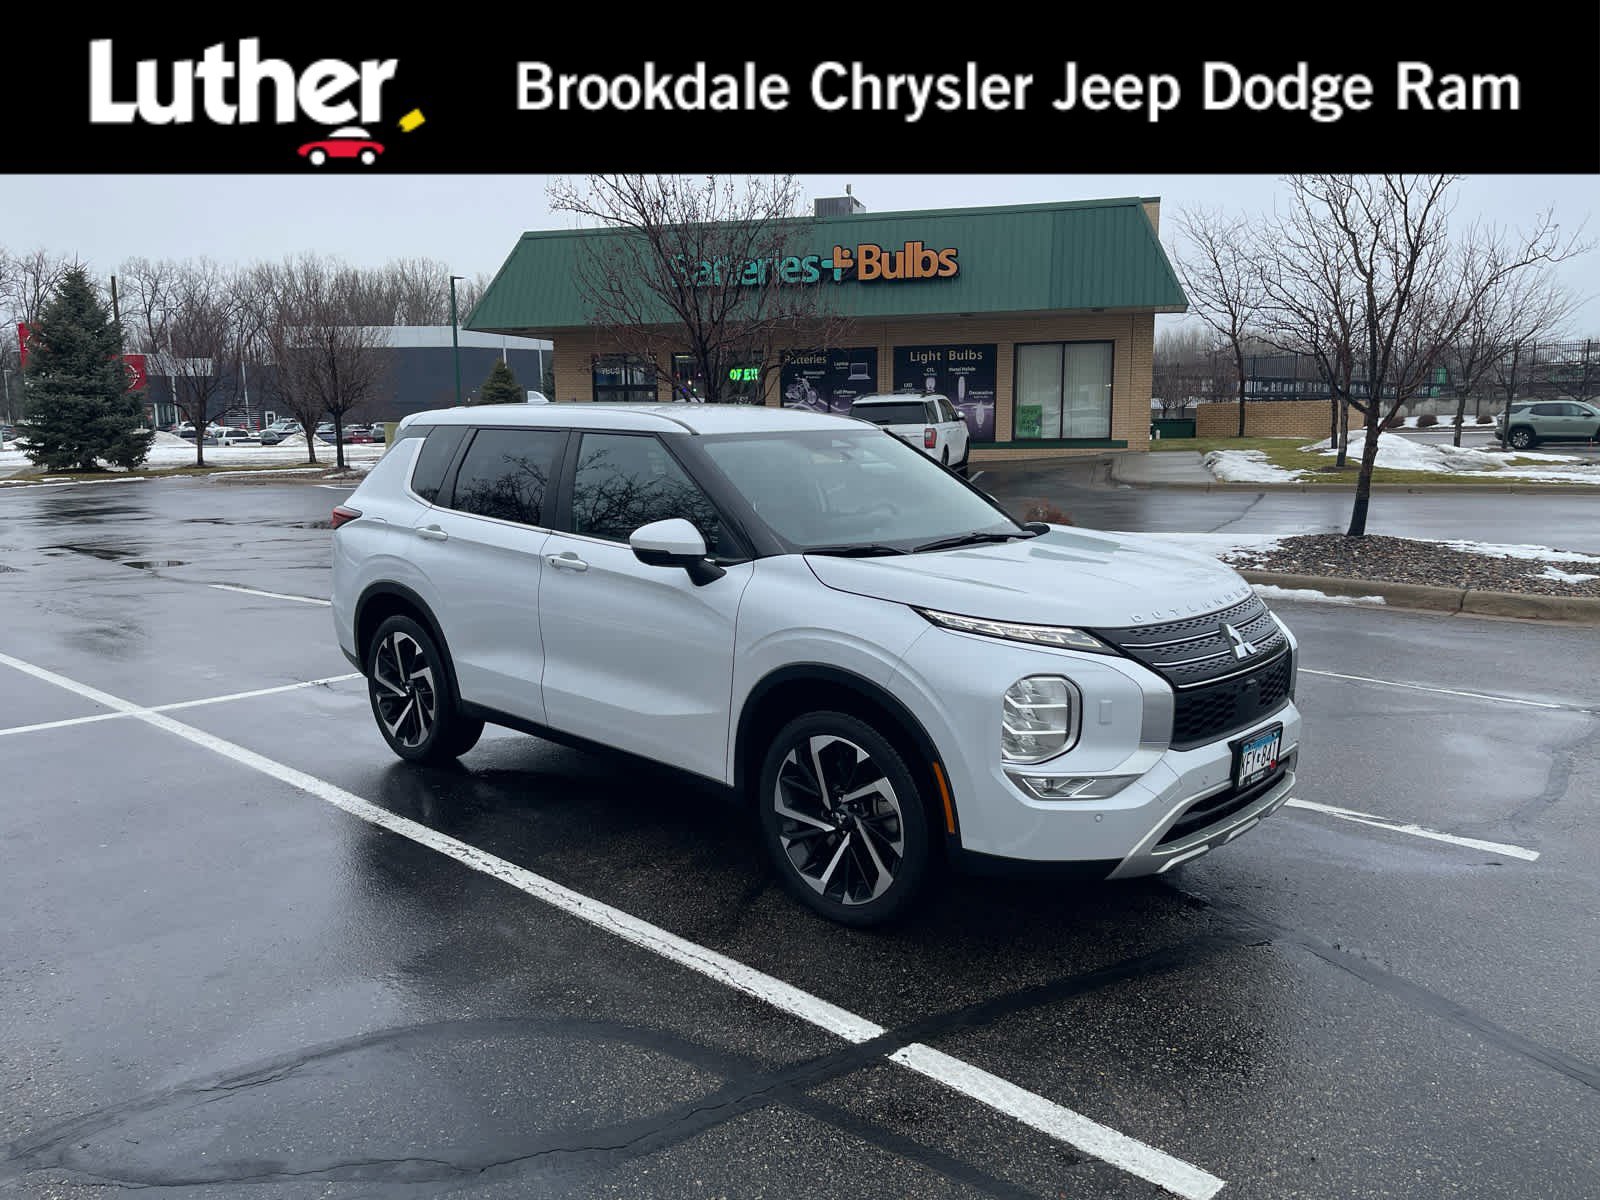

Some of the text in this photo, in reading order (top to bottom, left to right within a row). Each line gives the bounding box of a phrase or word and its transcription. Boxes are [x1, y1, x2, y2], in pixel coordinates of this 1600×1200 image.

[858, 241, 958, 280] Bulbs
[784, 354, 827, 365] Batteries
[910, 349, 983, 364] Light Bulbs
